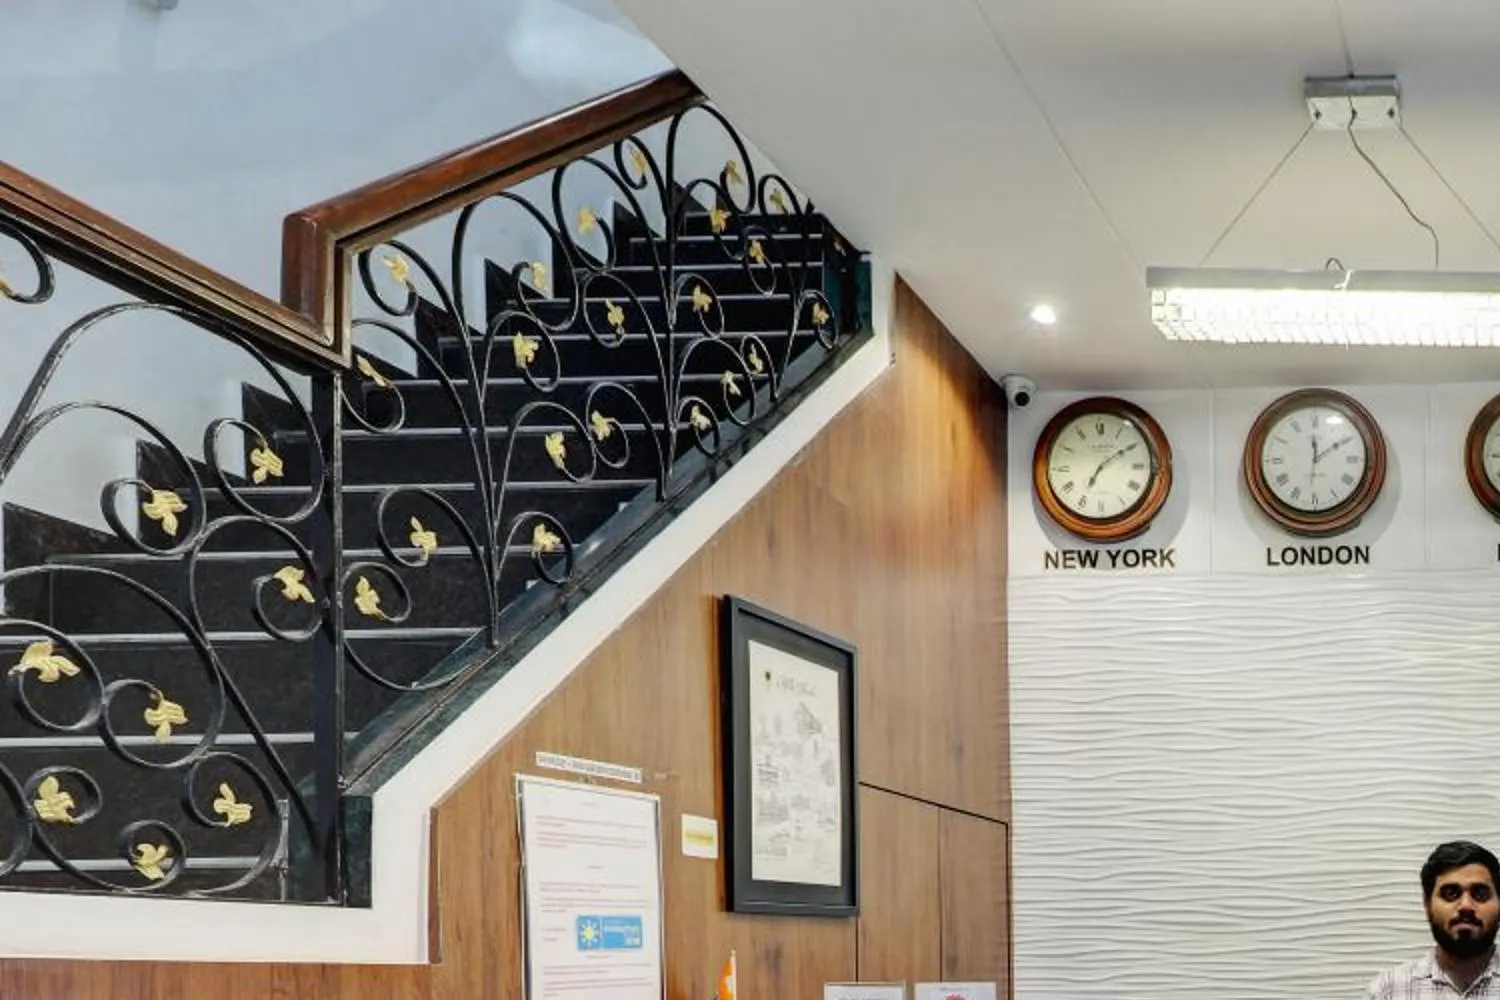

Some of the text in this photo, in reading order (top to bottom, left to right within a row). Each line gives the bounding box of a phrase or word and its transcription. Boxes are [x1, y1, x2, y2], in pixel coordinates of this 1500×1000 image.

[1045, 548, 1175, 569] NEW YORK
[1267, 545, 1370, 566] LONDON
